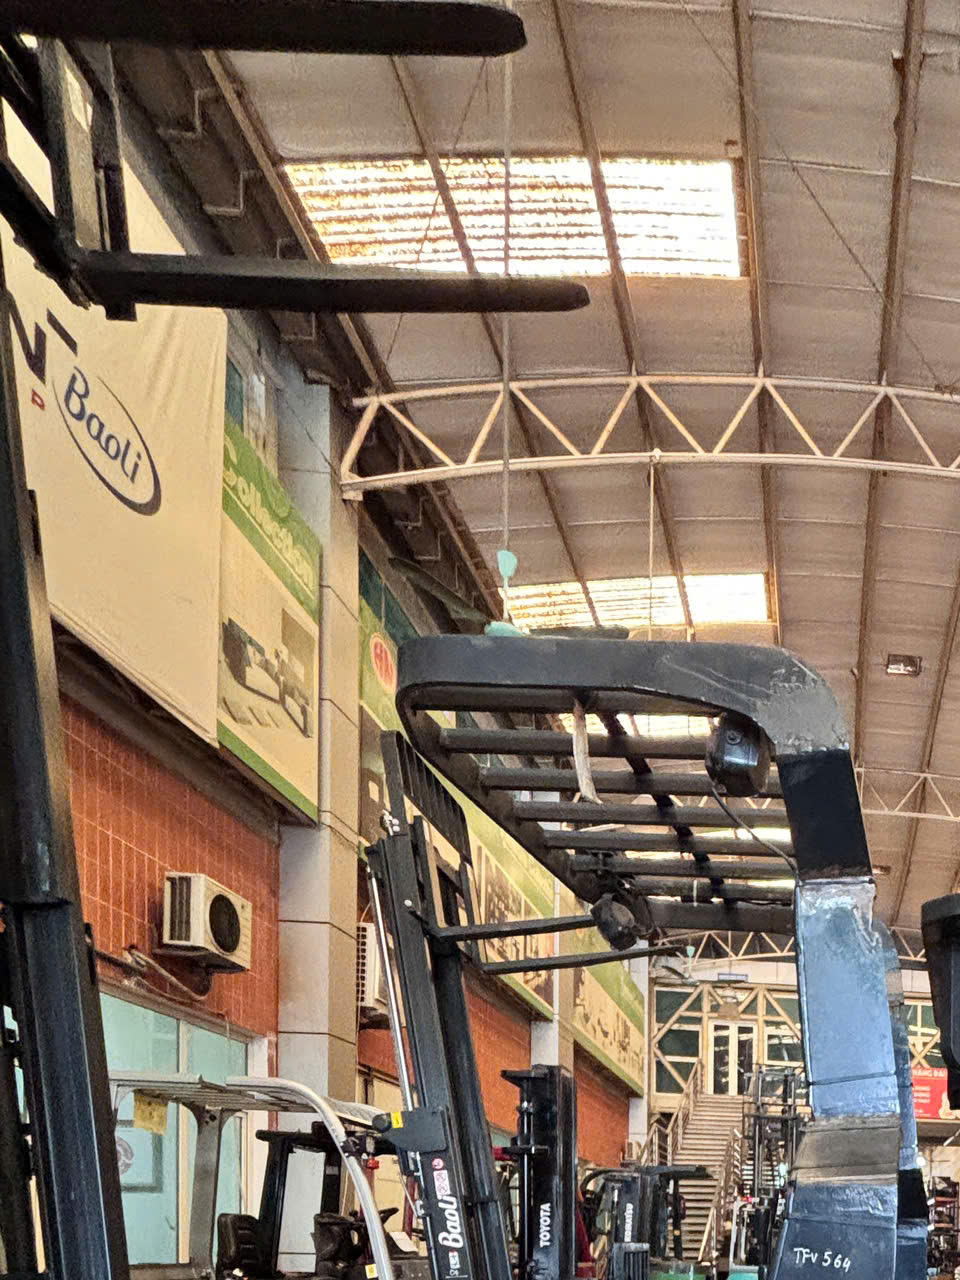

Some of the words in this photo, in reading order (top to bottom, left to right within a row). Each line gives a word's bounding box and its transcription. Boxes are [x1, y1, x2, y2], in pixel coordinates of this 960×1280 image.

[64, 366, 142, 484] Baoli
[539, 1203, 551, 1248] TOYOTA
[822, 1251, 851, 1273] 564
